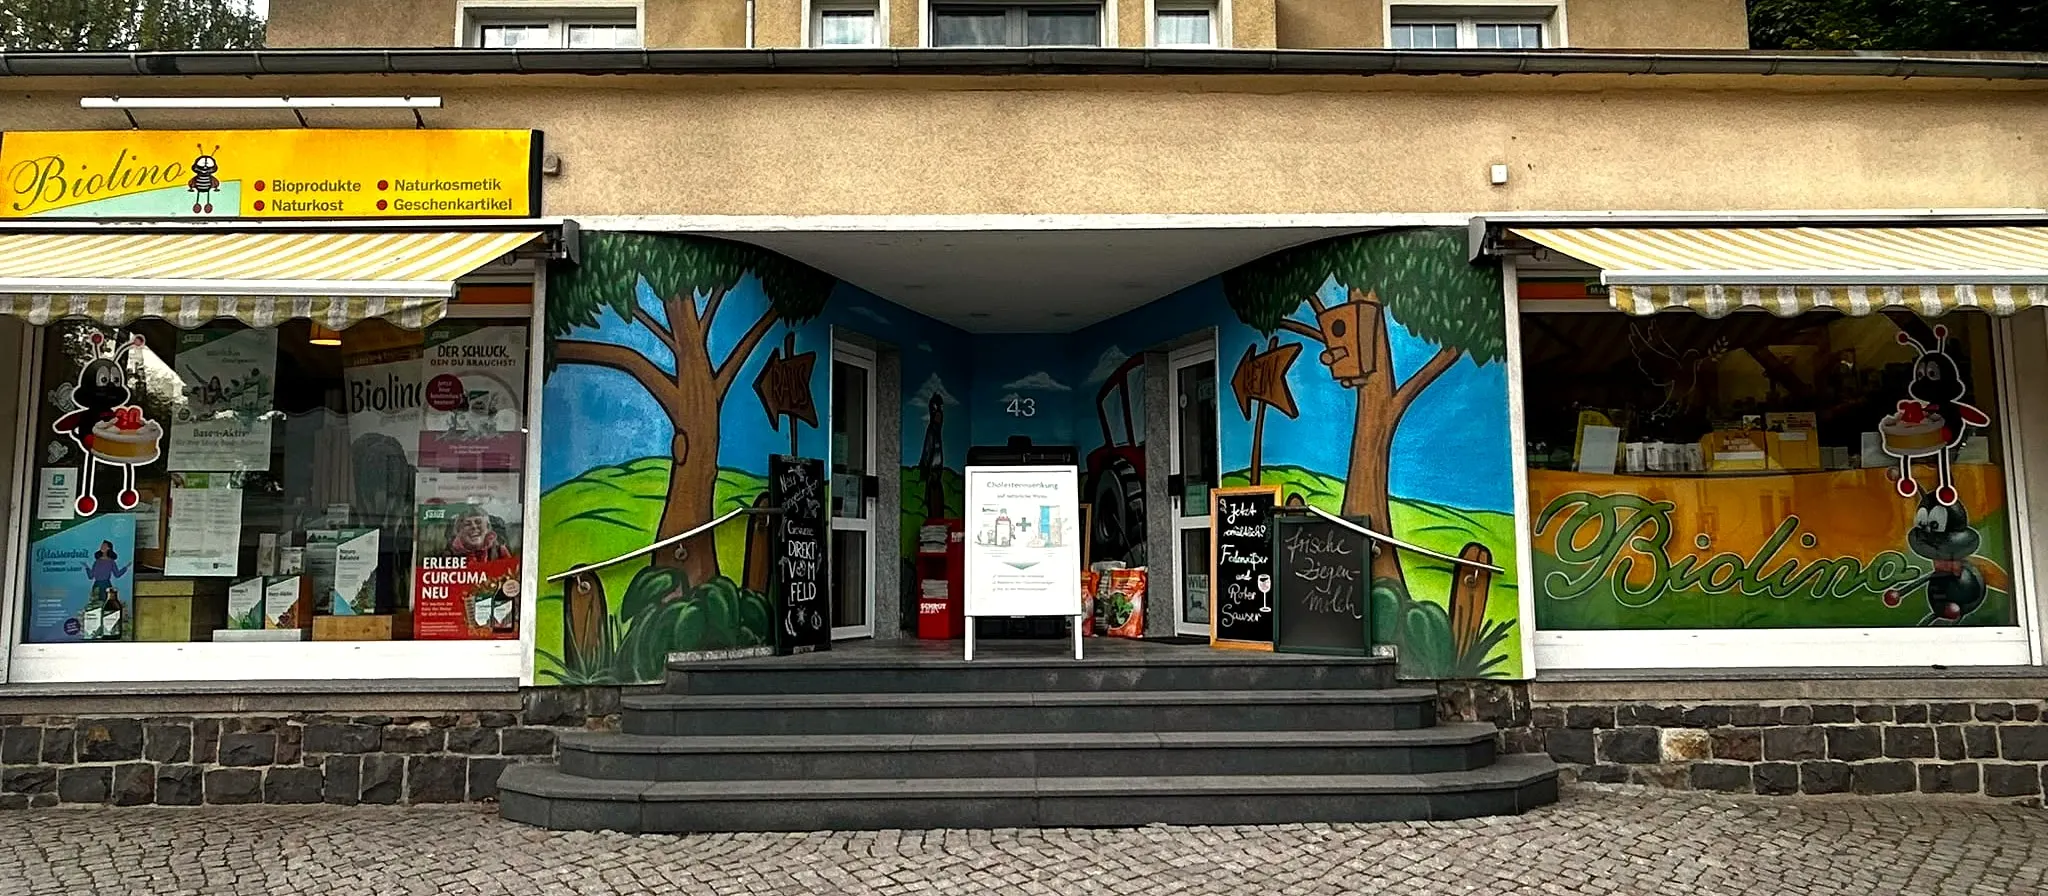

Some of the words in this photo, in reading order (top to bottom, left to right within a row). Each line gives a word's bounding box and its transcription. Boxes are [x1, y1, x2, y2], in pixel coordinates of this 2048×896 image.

[7, 148, 186, 212] Biolino
[272, 179, 362, 194] Bioprodukte
[394, 178, 502, 192] Naturkosmetik
[272, 198, 344, 212] Naturkost
[393, 198, 513, 212] Geschenkartikel
[438, 345, 459, 358] DER
[463, 345, 510, 358] SCHLUCK,
[466, 359, 517, 367] BRAUCHST!
[770, 363, 809, 405] RAUS
[1006, 398, 1035, 417] 43
[1227, 502, 1257, 524] Jetzt
[788, 540, 815, 560] DIREKT
[1535, 491, 1922, 608] Biolino
[423, 557, 467, 570] ERLEBE
[422, 572, 488, 585] CURCUMA
[421, 586, 449, 599] NEU
[791, 582, 816, 602] FELD
[1228, 583, 1257, 604] Roter
